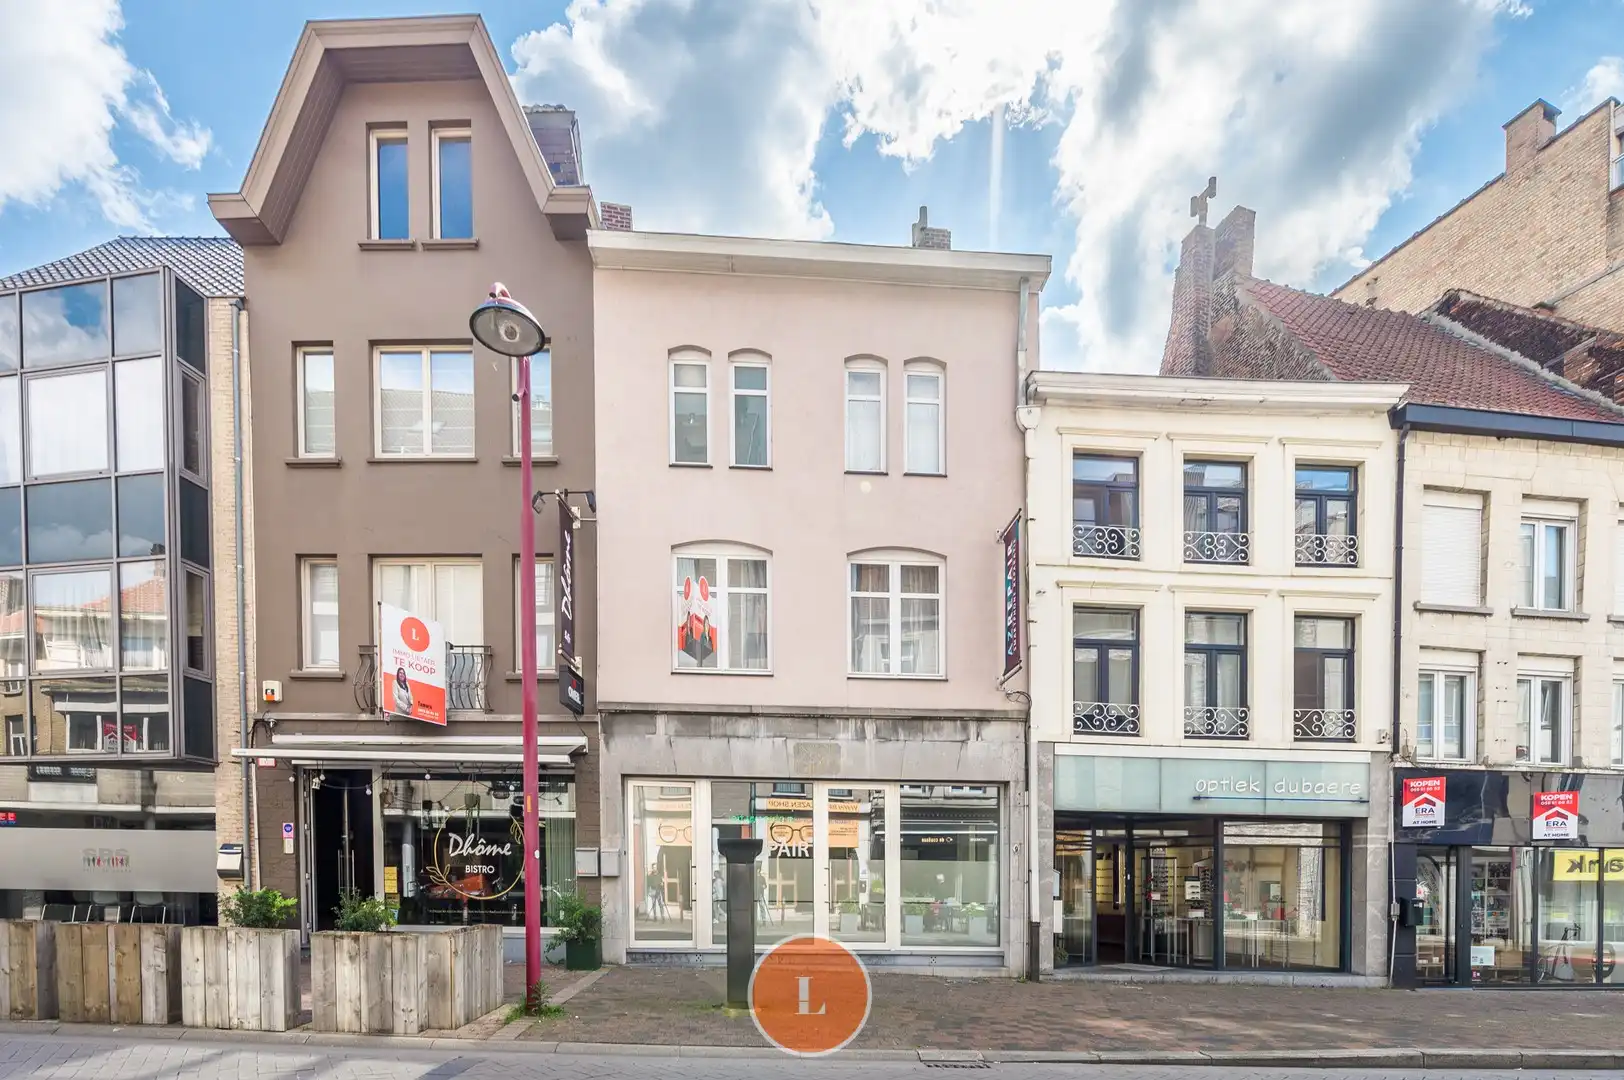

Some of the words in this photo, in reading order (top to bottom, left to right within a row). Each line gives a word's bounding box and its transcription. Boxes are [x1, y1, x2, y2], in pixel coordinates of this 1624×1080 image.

[411, 627, 420, 641] L
[393, 656, 406, 668] TE
[408, 660, 436, 676] KOOP
[1195, 775, 1261, 794] optiek
[1274, 777, 1362, 795] dubaere
[1410, 779, 1440, 788] KOPEN
[1540, 793, 1573, 801] KOPEN
[448, 832, 512, 857] Dhôme
[465, 864, 495, 874] BISTRO
